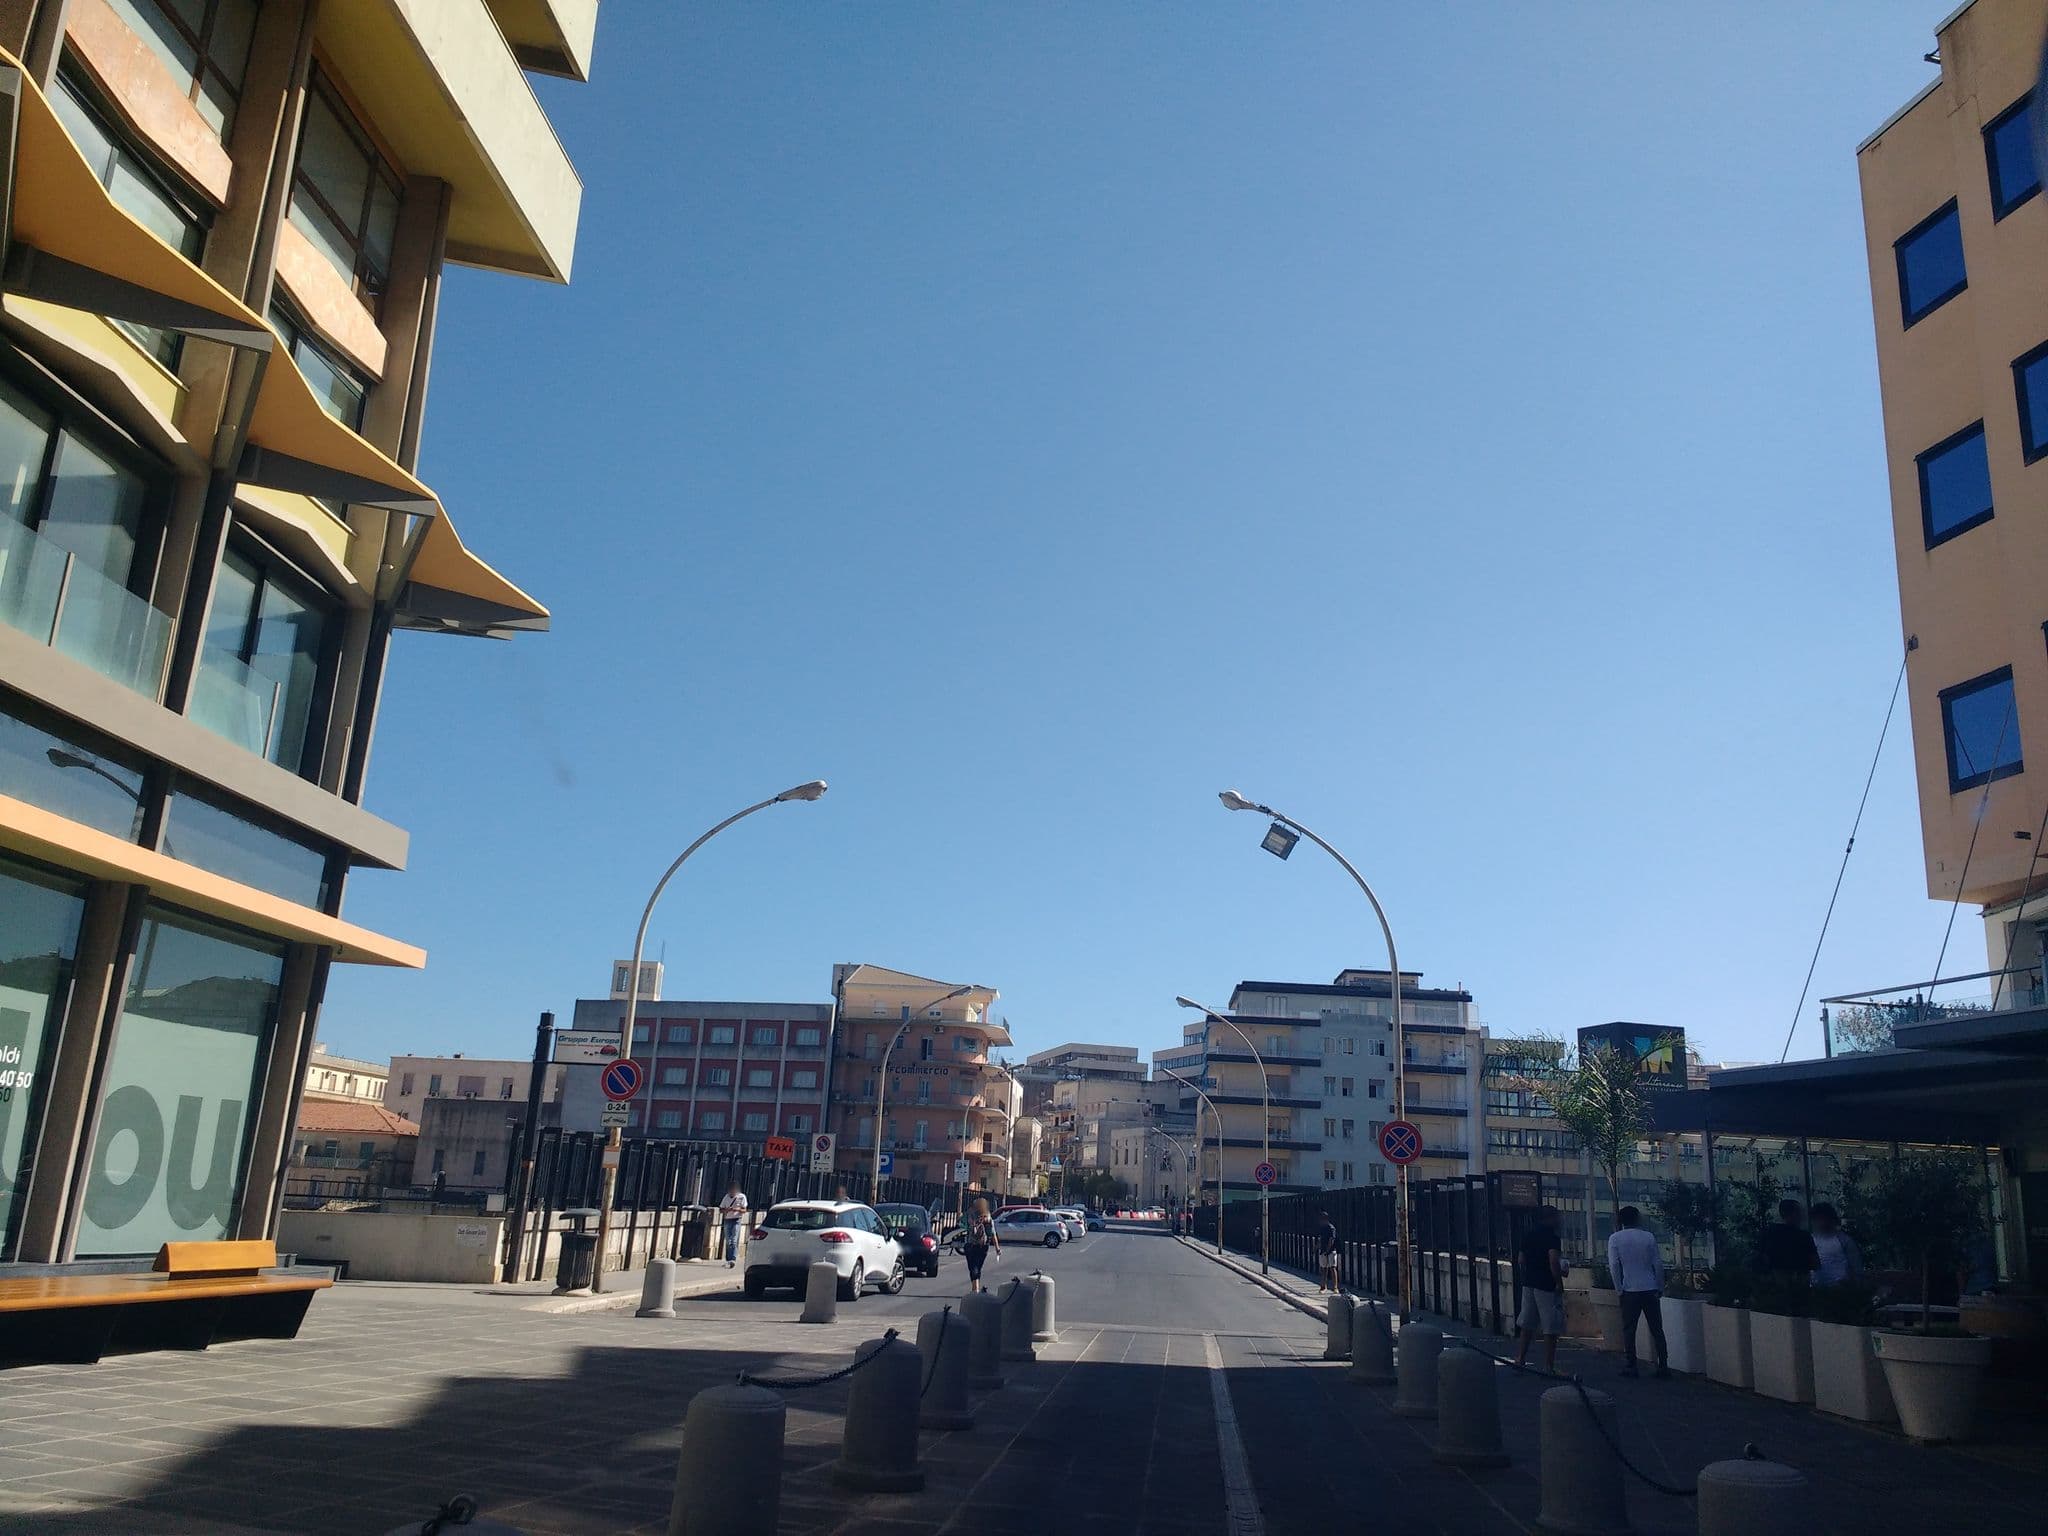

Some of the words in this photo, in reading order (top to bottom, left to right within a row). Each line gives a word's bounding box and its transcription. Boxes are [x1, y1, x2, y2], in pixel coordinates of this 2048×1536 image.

[591, 1036, 620, 1044] Europa
[607, 1103, 627, 1111] 0-24
[769, 1142, 793, 1152] TAXI
